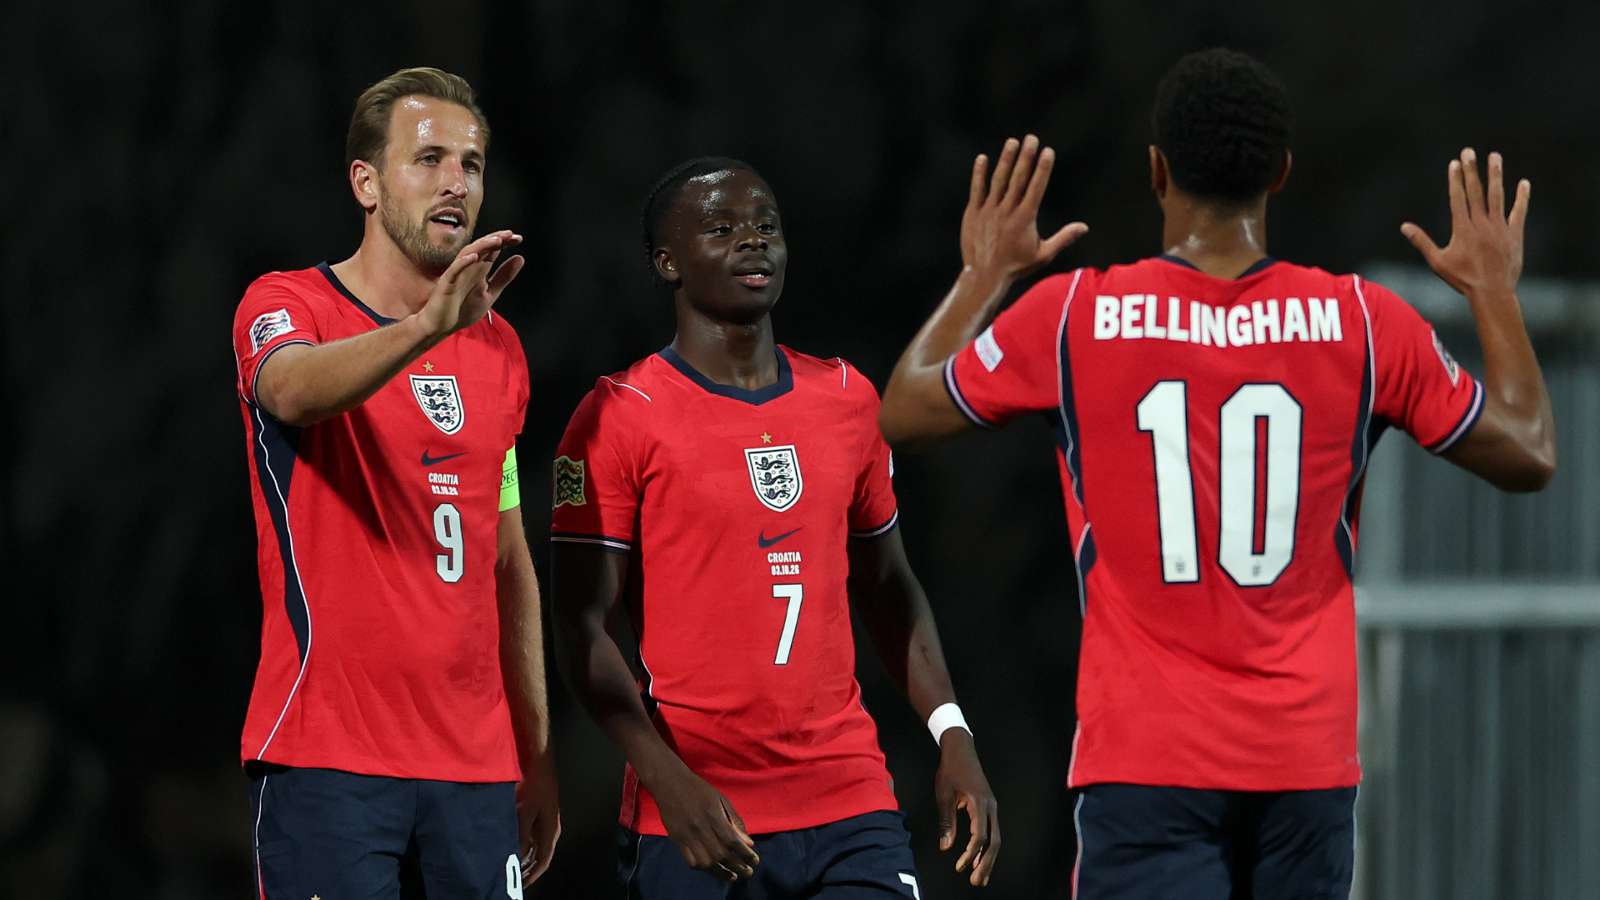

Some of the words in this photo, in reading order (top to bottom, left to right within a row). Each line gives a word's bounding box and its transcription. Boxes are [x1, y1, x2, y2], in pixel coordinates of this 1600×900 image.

[1094, 294, 1343, 348] BELLINGHAM
[428, 472, 459, 485] CROATIA
[1136, 379, 1303, 587] 10
[433, 502, 464, 583] 9
[767, 551, 802, 563] CROATIA
[772, 583, 804, 665] 7
